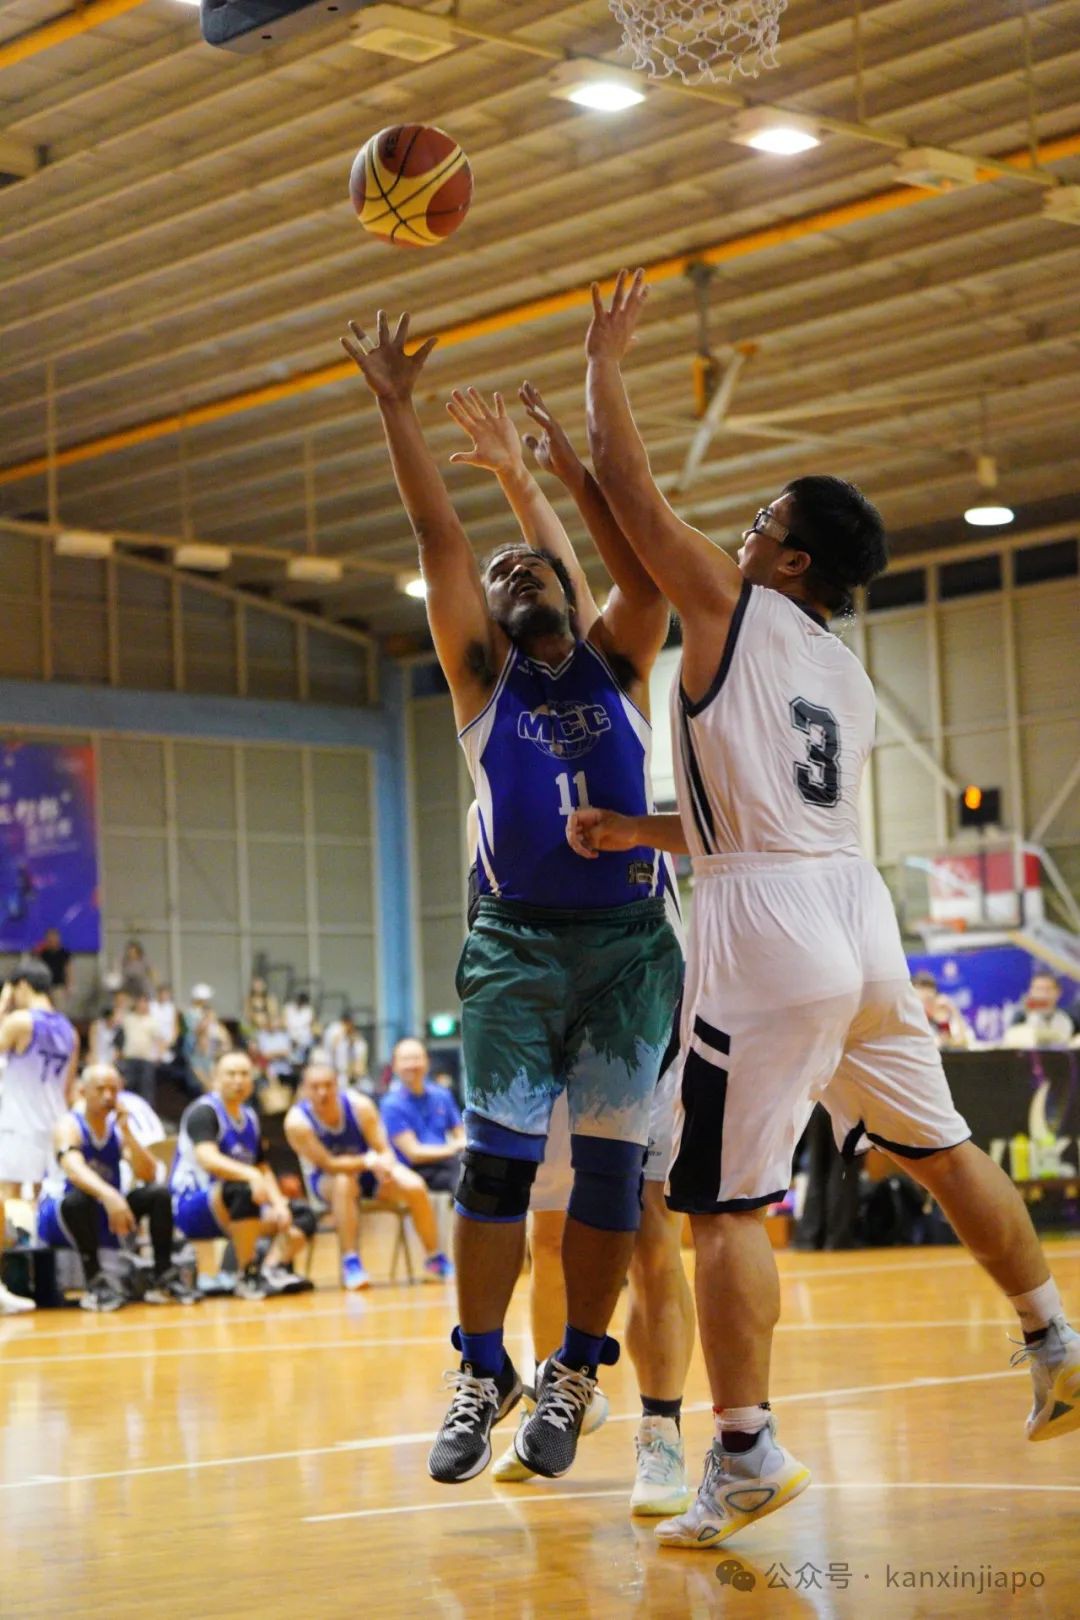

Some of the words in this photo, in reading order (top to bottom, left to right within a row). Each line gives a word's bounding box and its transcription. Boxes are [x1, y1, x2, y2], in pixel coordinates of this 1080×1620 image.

[518, 704, 612, 743] MCC
[789, 696, 841, 808] 3
[555, 770, 592, 815] 11
